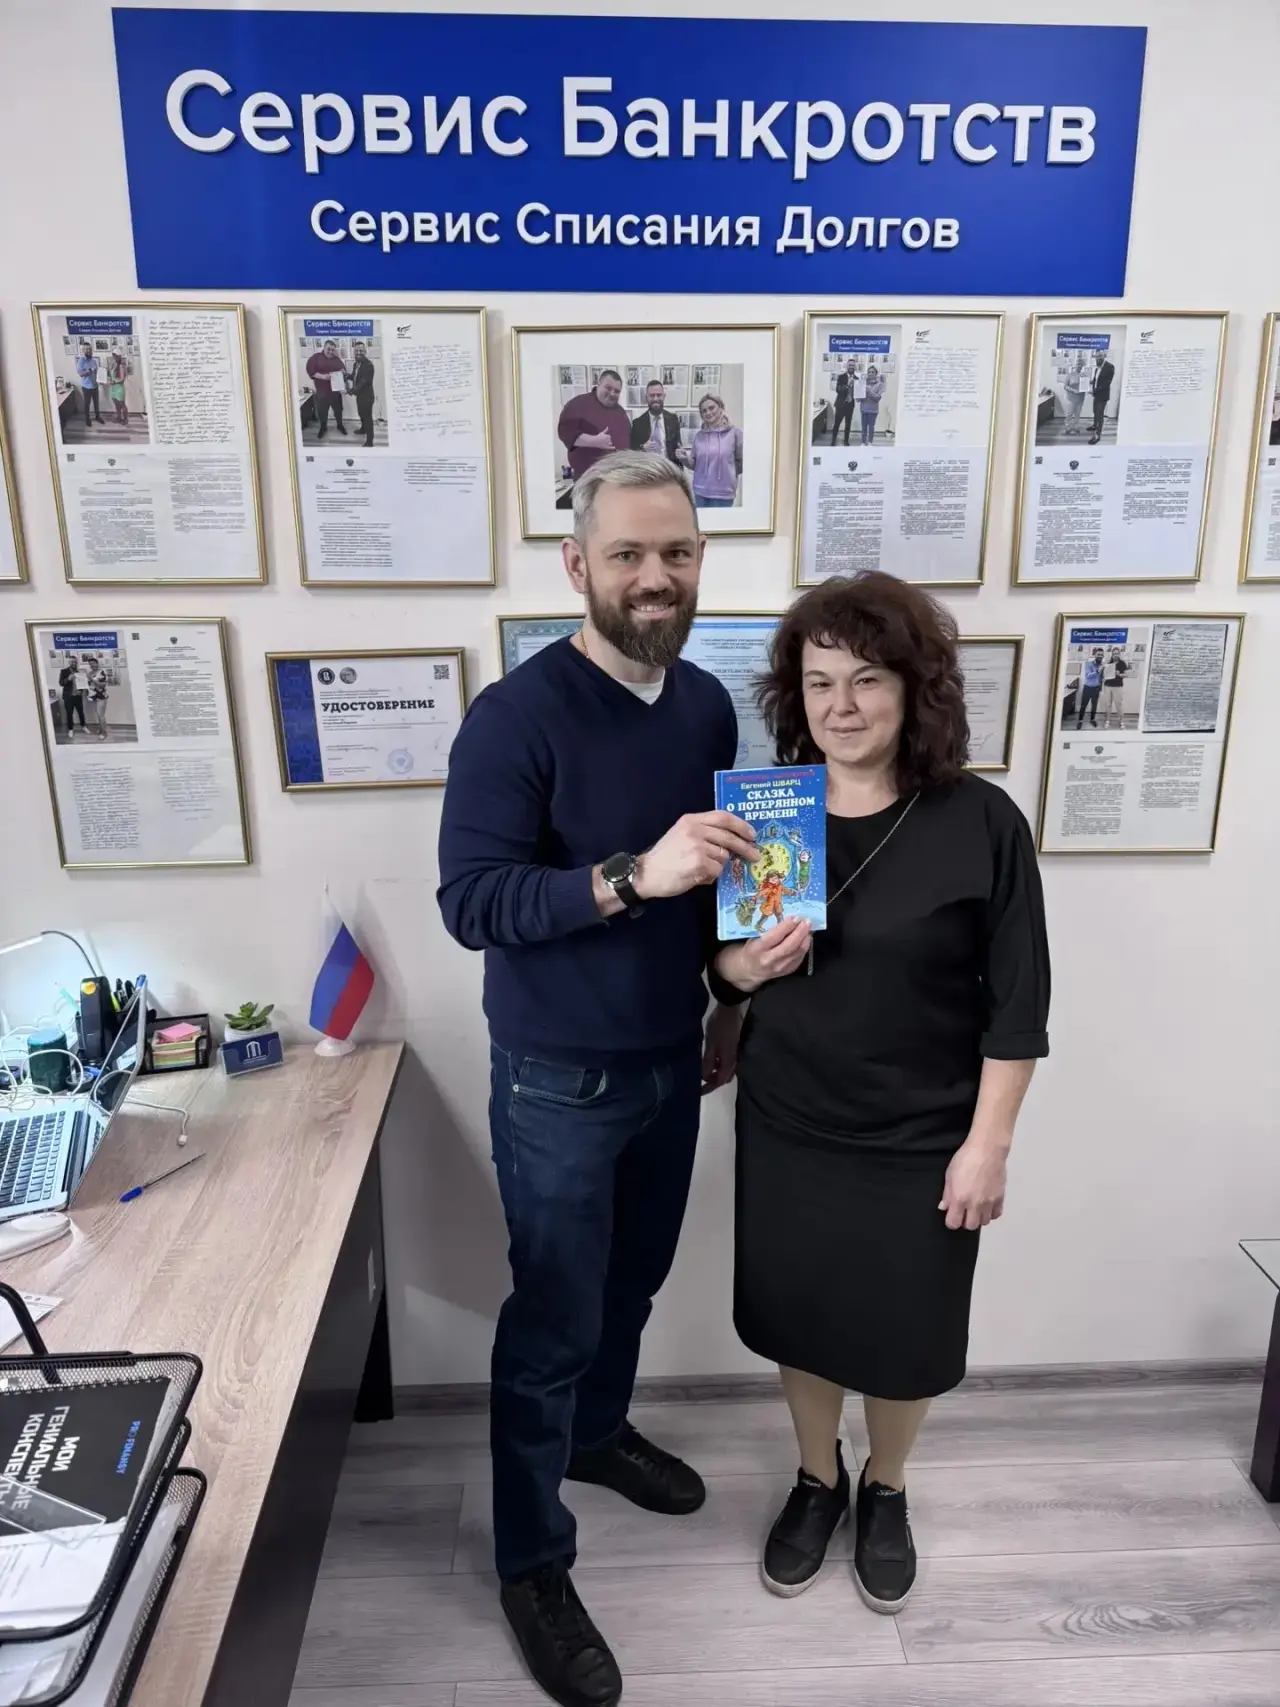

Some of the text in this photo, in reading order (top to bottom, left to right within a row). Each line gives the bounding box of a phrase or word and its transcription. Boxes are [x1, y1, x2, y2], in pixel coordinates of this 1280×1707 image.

[165, 69, 1096, 180] Сервис Банкротств
[309, 199, 961, 255] Сервис Списания Долгов
[320, 699, 435, 713] УДОСТОВЕРЕНИЕ
[740, 779, 801, 790] Евгений ШВАРЦ
[746, 788, 795, 801] СКАЗКА
[726, 796, 816, 812] О ПОТЕРЯННОМ
[744, 808, 798, 821] ВРЕМЕНИ
[10, 1405, 70, 1510] ГЕНИАЛЬНЫЕ
[51, 1436, 80, 1472] МОИ
